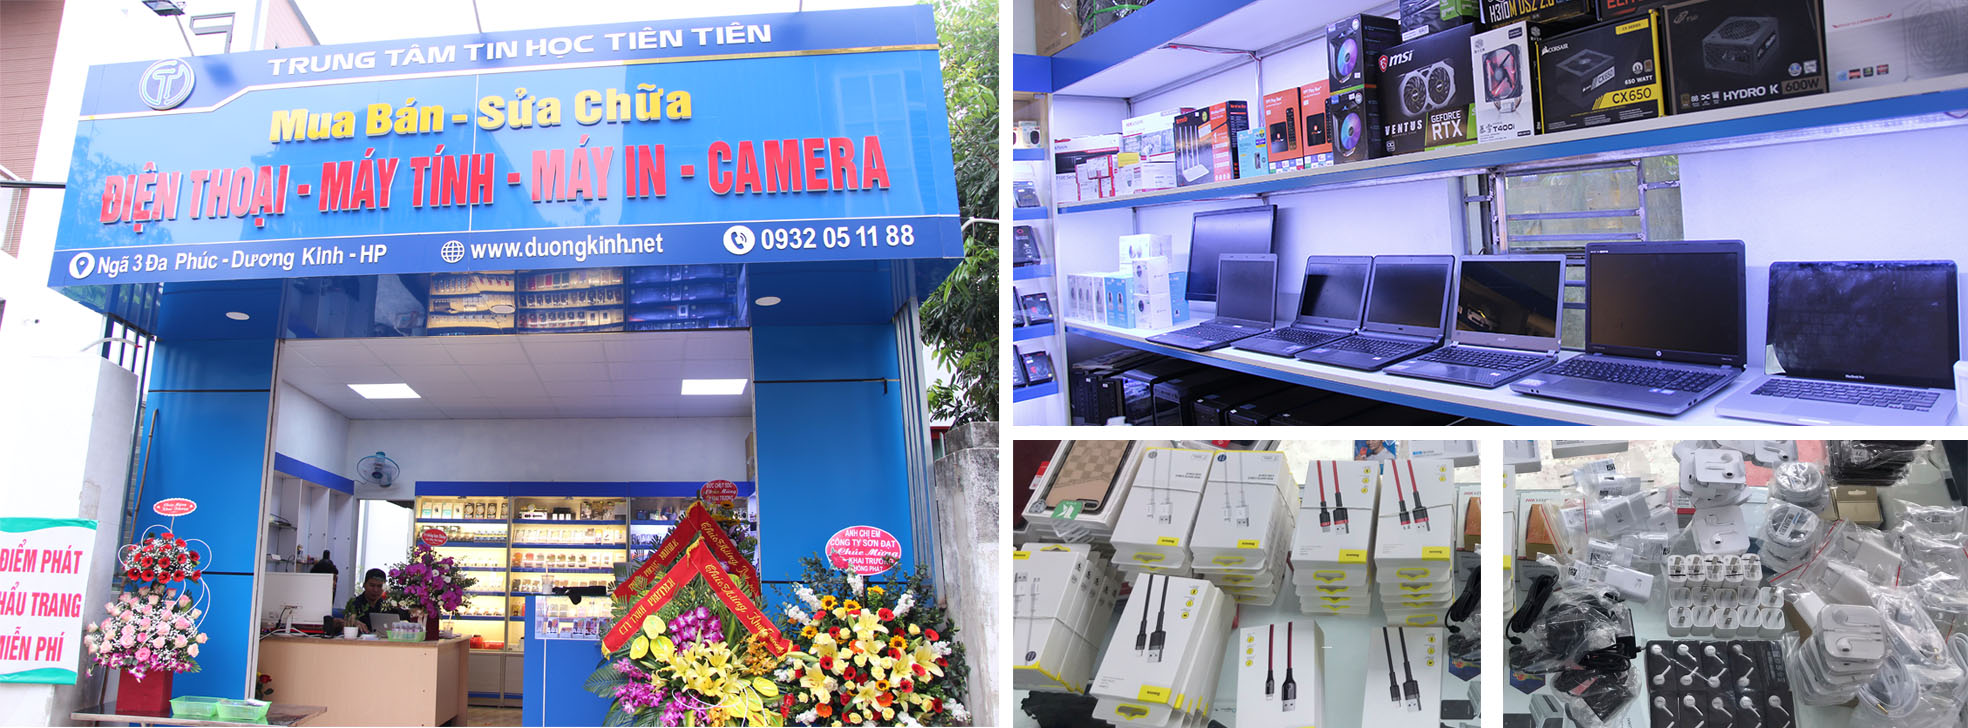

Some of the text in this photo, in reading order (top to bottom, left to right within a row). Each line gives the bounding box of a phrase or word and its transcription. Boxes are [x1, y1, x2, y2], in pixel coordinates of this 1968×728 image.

[1489, 0, 1517, 22] H310M
[268, 51, 376, 76] TRUNG
[384, 44, 456, 66] TÂM
[464, 39, 518, 61] TIN
[526, 33, 594, 60] HỌC
[604, 26, 683, 51] TIÊN
[1548, 43, 1568, 52] CORSAIR
[1389, 50, 1413, 67] msi
[1723, 84, 1778, 101] HYDRO K
[1785, 78, 1820, 92] 600W
[1612, 88, 1652, 104] CX650
[270, 107, 355, 144] Mua
[365, 97, 444, 137] Bán
[478, 88, 562, 130] Sửa
[574, 82, 692, 126] Chữa
[1431, 110, 1461, 123] GEFORCE
[1385, 120, 1423, 136] VENTUS
[1432, 119, 1463, 140] RTX
[100, 161, 181, 232] ĐIỆN
[189, 164, 290, 228] THOẠI
[318, 148, 399, 213] MÁY
[409, 144, 495, 208] TÍNH
[531, 134, 614, 203] MÁY
[624, 144, 666, 199] IN
[707, 134, 891, 196] CAMERA
[470, 232, 663, 262] www.duongkinh.net
[761, 224, 915, 252] 0932 05 11 88
[98, 255, 130, 278] Ngã
[133, 254, 142, 272] 3
[145, 253, 168, 272] Đa
[174, 251, 218, 270] Phúc
[232, 250, 294, 270] Dương
[360, 244, 387, 263] HP
[830, 537, 850, 546] CÔNG
[881, 540, 895, 549] ĐẠT
[859, 530, 870, 539] CHỊ
[0, 538, 83, 574] ĐIỂM PHÁT
[31, 592, 82, 618] TRANG
[630, 604, 647, 624] TNHH
[35, 632, 65, 662] PHÍ
